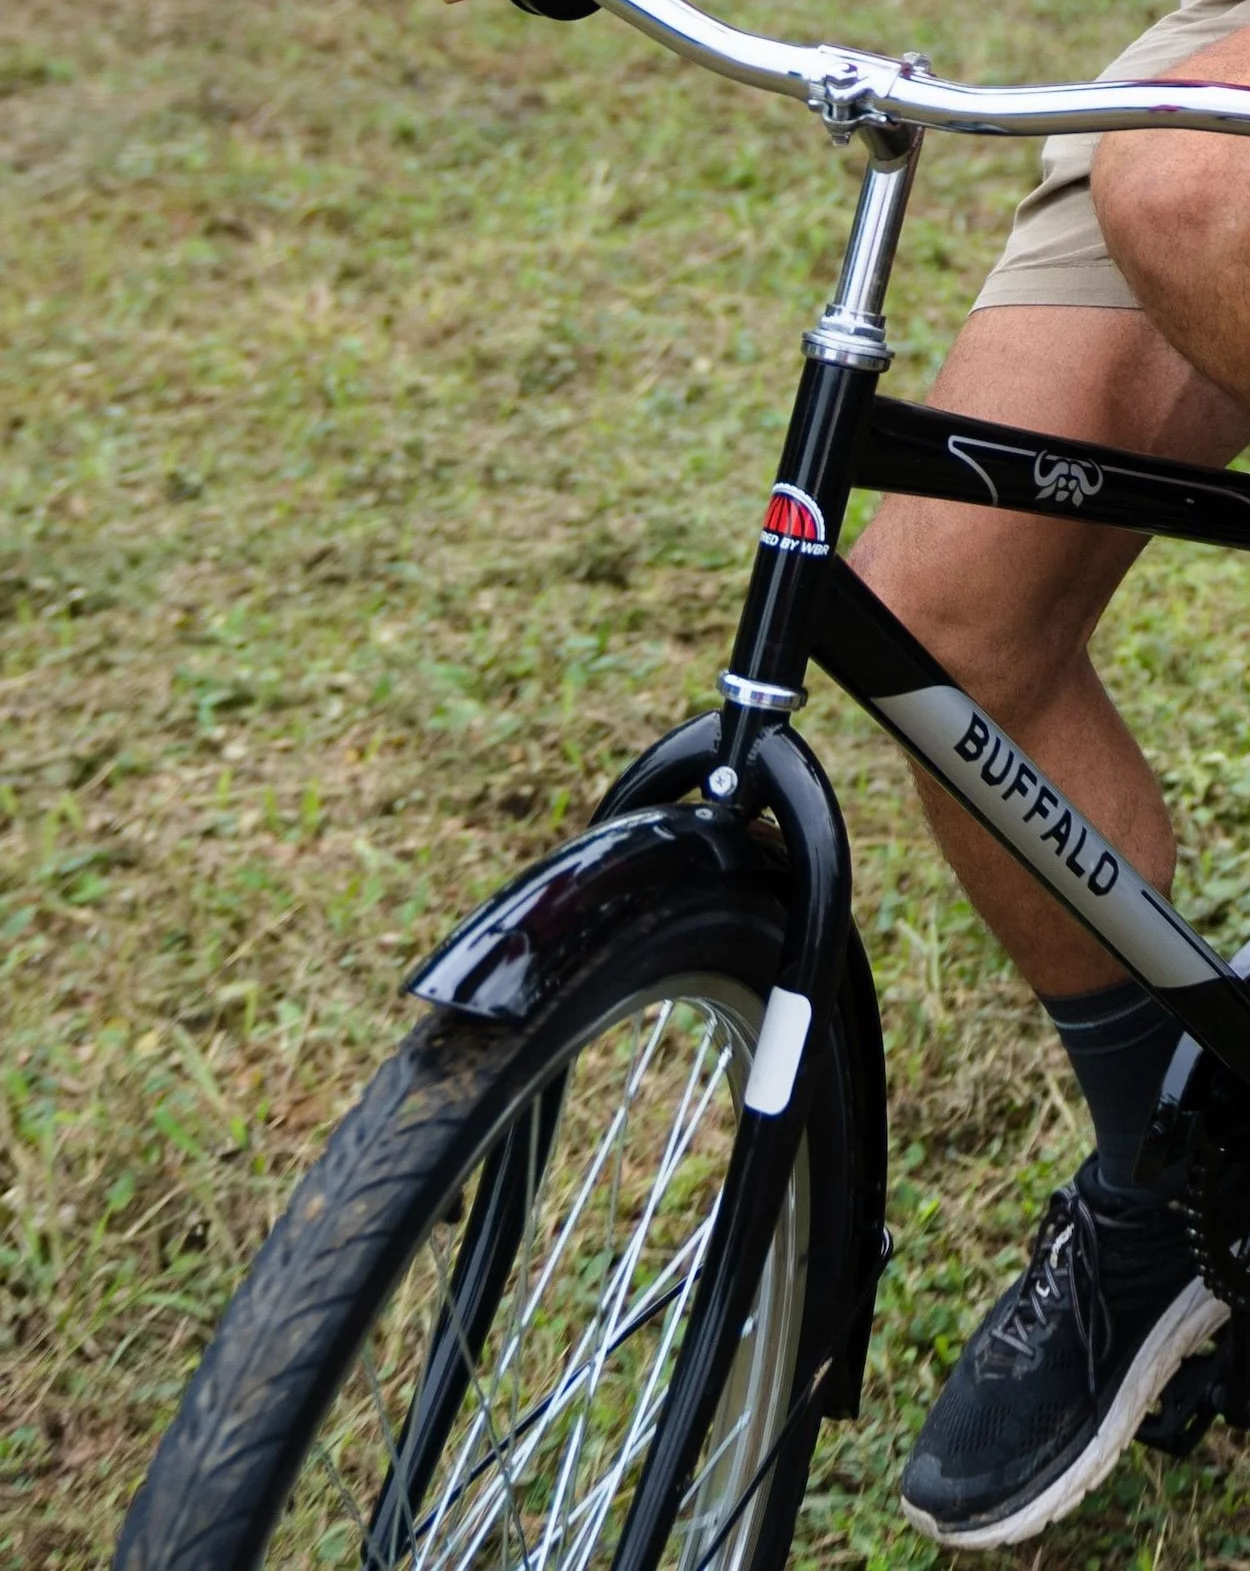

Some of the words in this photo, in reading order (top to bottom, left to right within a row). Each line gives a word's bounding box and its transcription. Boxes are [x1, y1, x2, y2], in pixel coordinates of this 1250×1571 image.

[780, 537, 800, 551] BY
[801, 541, 830, 556] WBR
[953, 710, 1120, 897] BUFFALO
